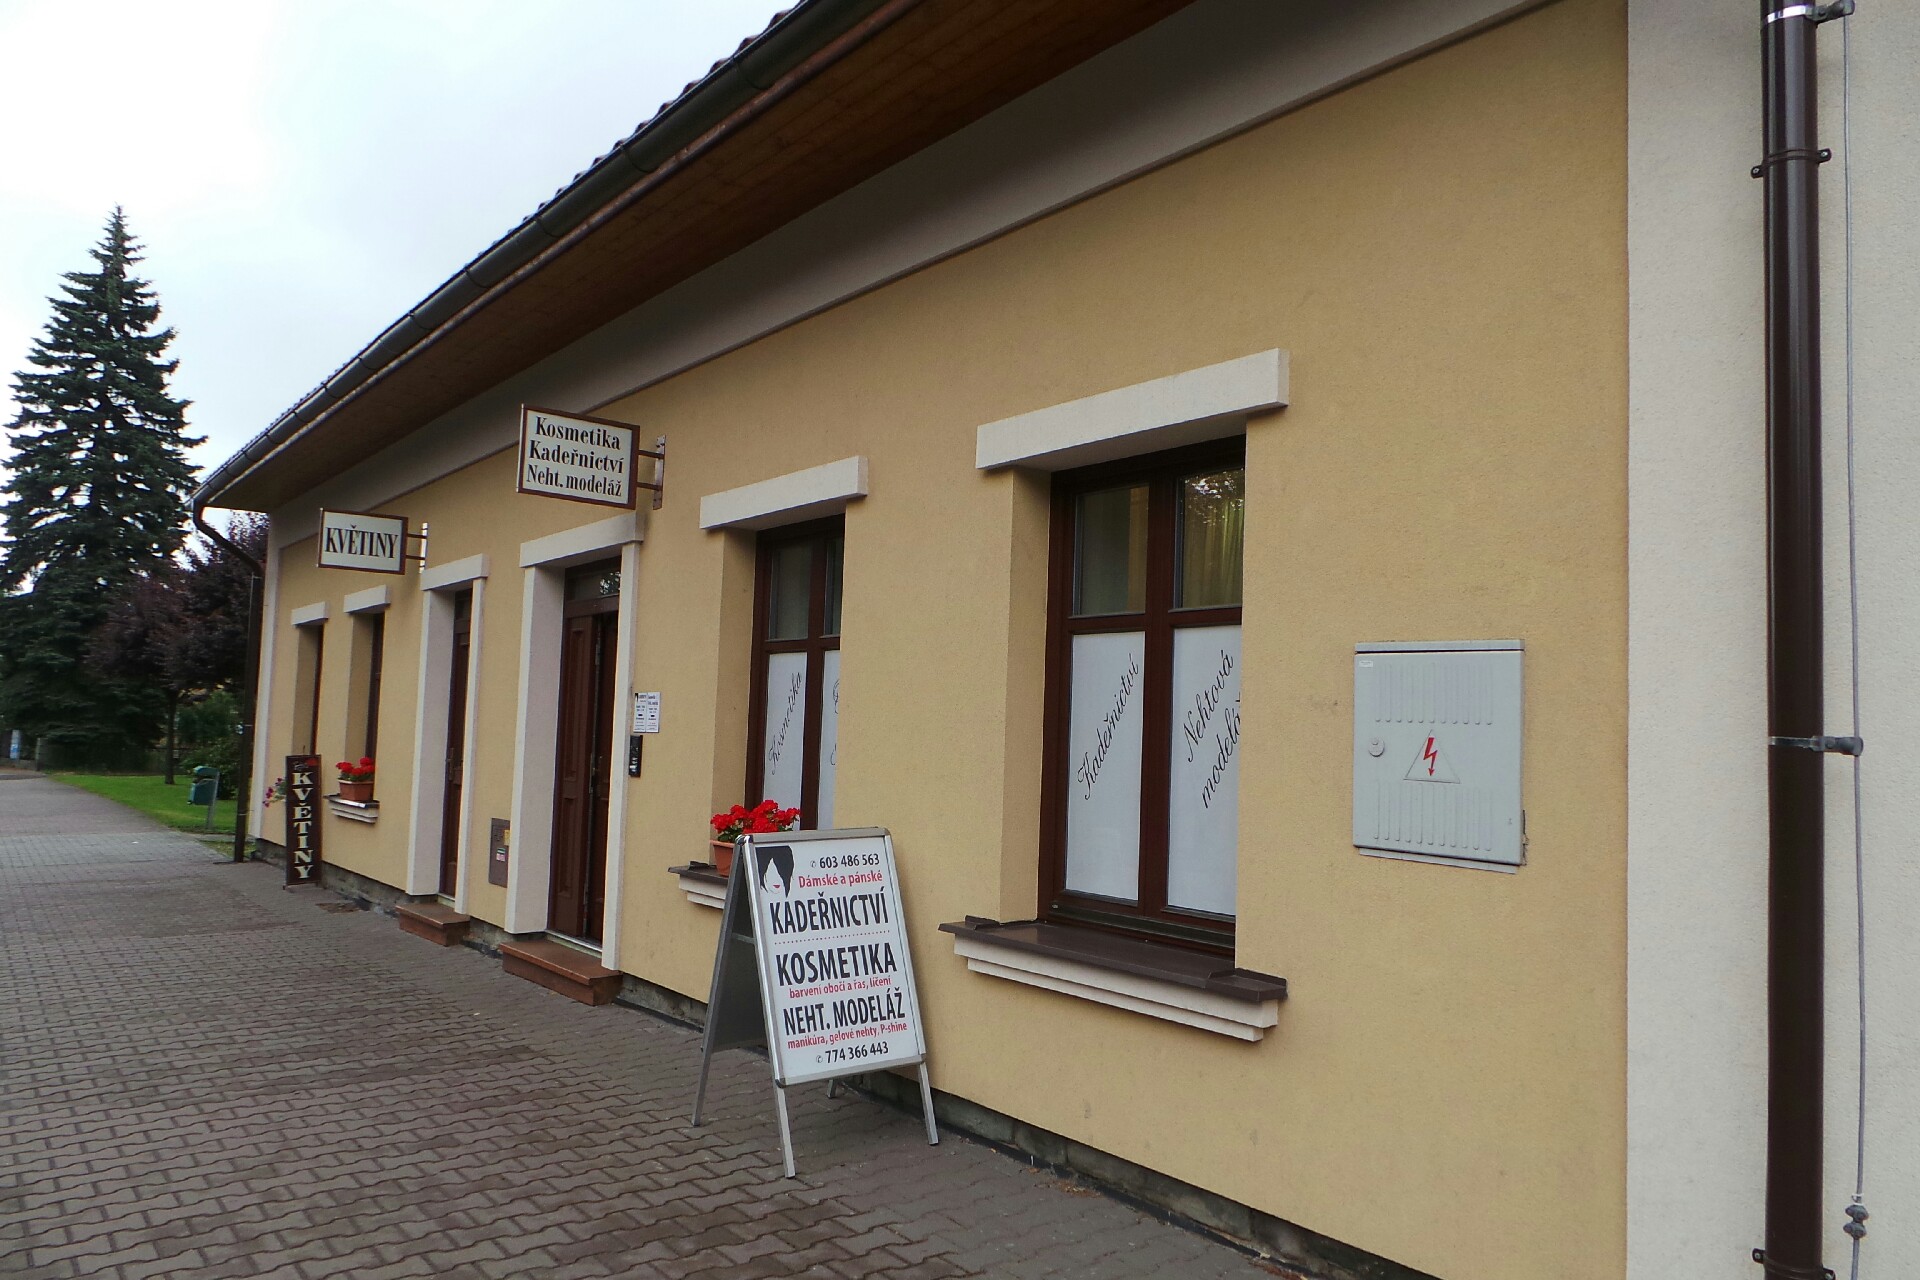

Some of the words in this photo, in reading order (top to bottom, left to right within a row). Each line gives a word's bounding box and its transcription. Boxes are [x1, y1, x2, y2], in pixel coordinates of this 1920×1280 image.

[535, 416, 621, 450] Kosmetika
[529, 440, 625, 473] Kadeřnictví
[526, 464, 564, 488] Neht.
[566, 475, 622, 497] modeláž
[325, 524, 399, 558] KVĚTINY
[1183, 649, 1234, 763] Nehtová
[1077, 652, 1139, 800] Kadeřnictví
[1202, 692, 1241, 809] modelá
[292, 771, 313, 879] KVĚTINY
[819, 856, 839, 869] 603
[841, 854, 860, 868] 486
[862, 853, 880, 867] 563
[798, 873, 838, 889] Dámské
[840, 874, 846, 885] a
[848, 870, 883, 887] pánské
[769, 886, 889, 935] KADEŘNICTVÍ
[775, 942, 897, 987] KOSMETIKA
[789, 984, 822, 999] barvení
[823, 981, 846, 995] obočí
[847, 982, 853, 991] a
[853, 979, 869, 991] řas,
[869, 975, 892, 988] líčení
[783, 1003, 831, 1036] NEHT.
[832, 987, 906, 1029] MODELÁŽ
[788, 1035, 829, 1050] manikúra,
[829, 1028, 855, 1046] gelové
[855, 1025, 880, 1040] nehty,
[880, 1021, 908, 1035] P-shine
[825, 1049, 846, 1064] 774
[848, 1044, 868, 1060] 366
[869, 1041, 889, 1055] 443
